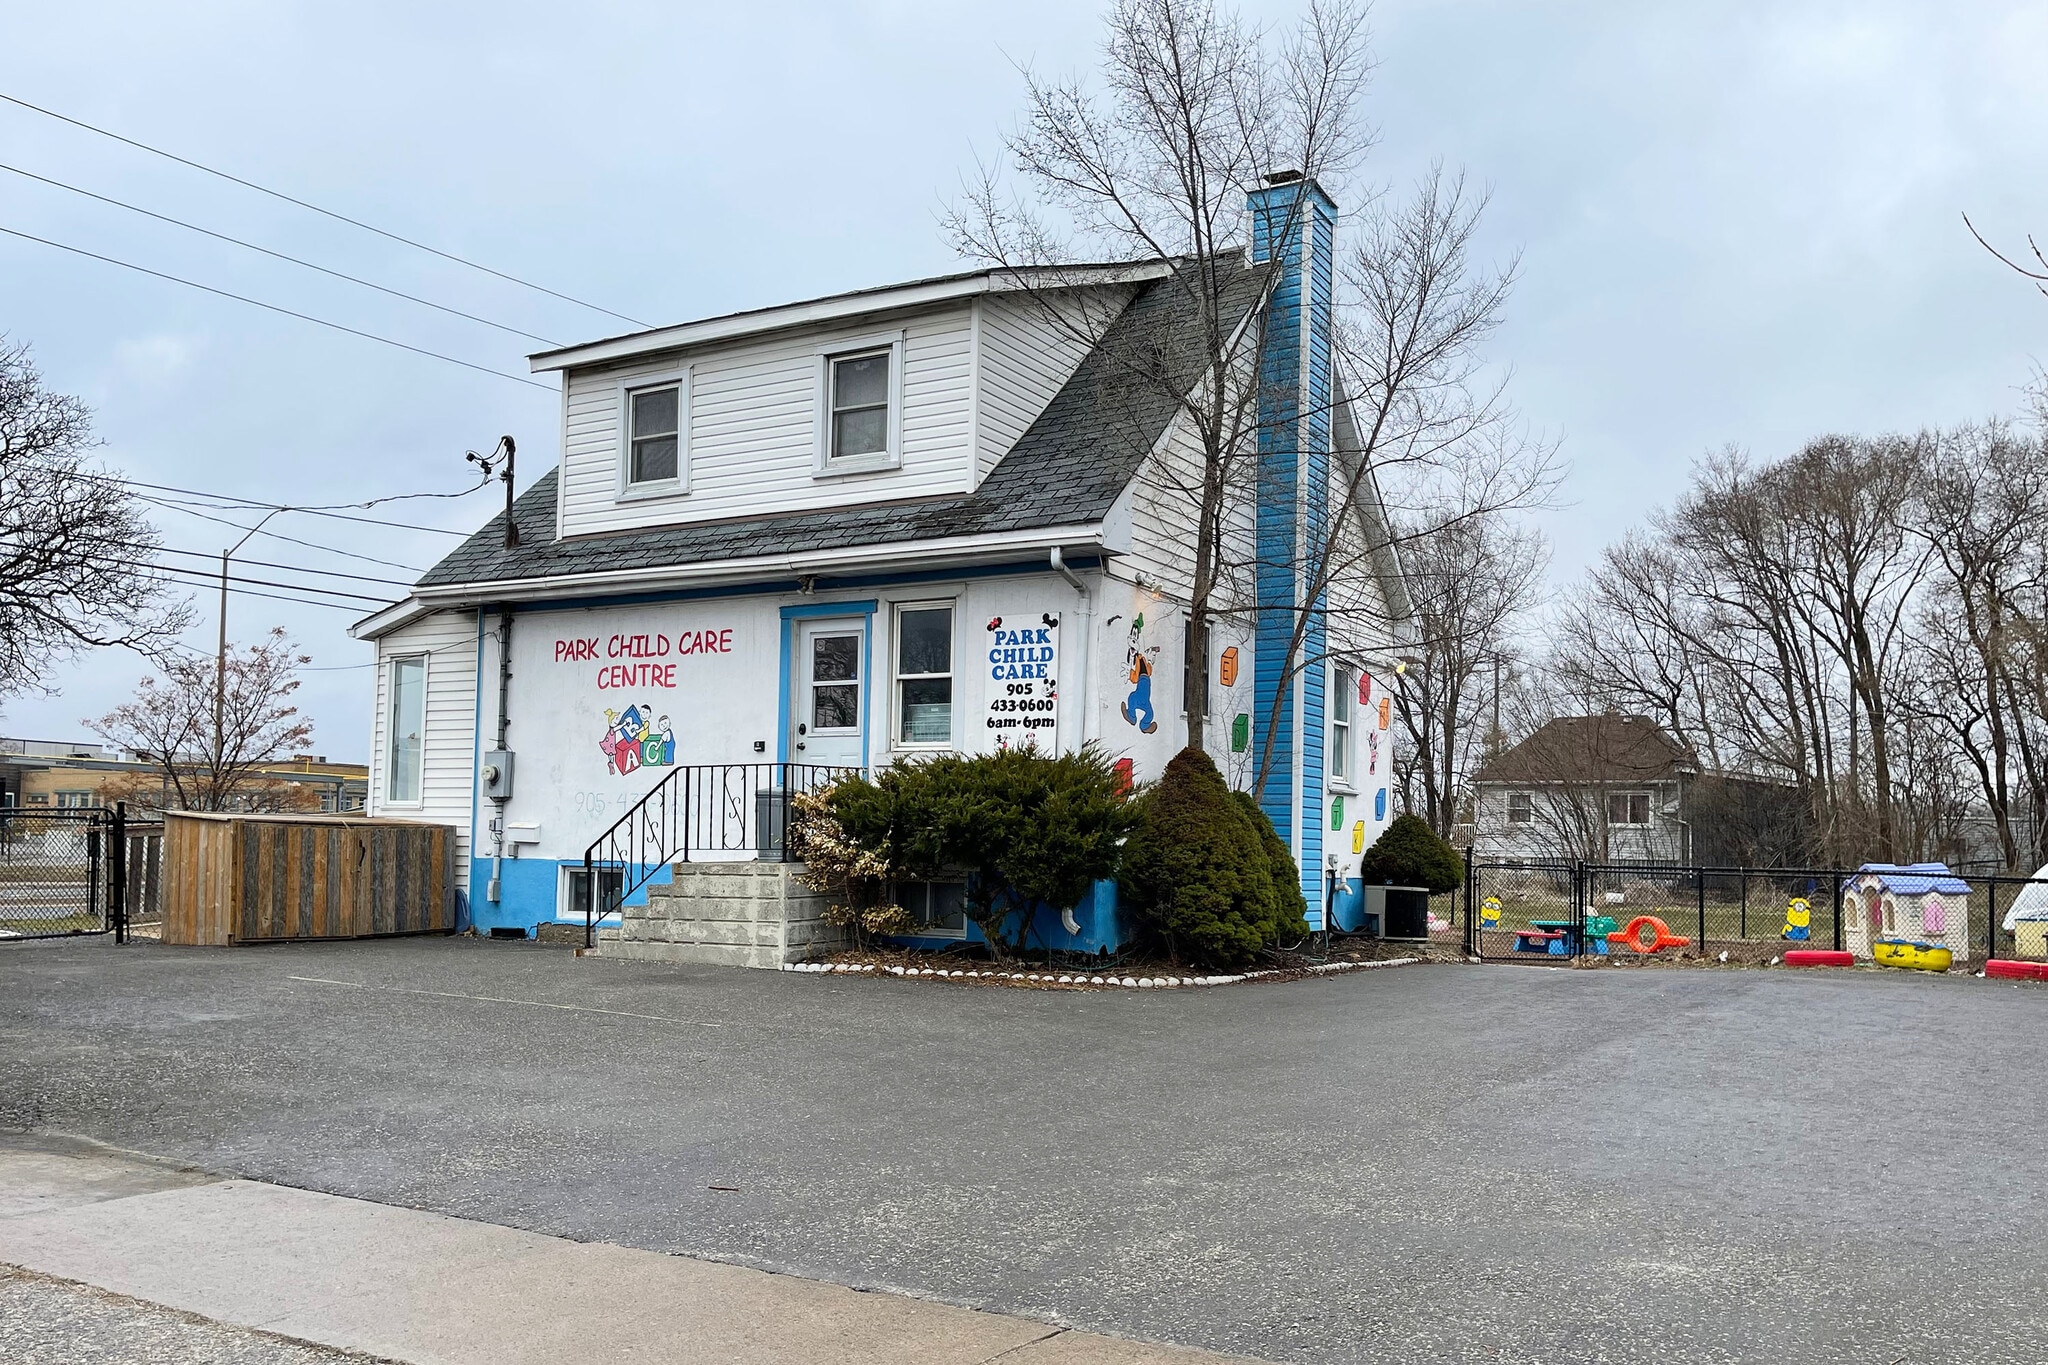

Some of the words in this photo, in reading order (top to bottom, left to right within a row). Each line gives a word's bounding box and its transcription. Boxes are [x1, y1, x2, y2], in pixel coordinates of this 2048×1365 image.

[555, 637, 600, 662] PARK
[607, 634, 670, 658] CHILD
[678, 629, 733, 655] CARE
[994, 628, 1051, 646] PARK
[989, 646, 1054, 663] CHILD
[597, 664, 677, 689] CENTRE
[992, 663, 1048, 681] CARE
[1006, 683, 1033, 696] 905
